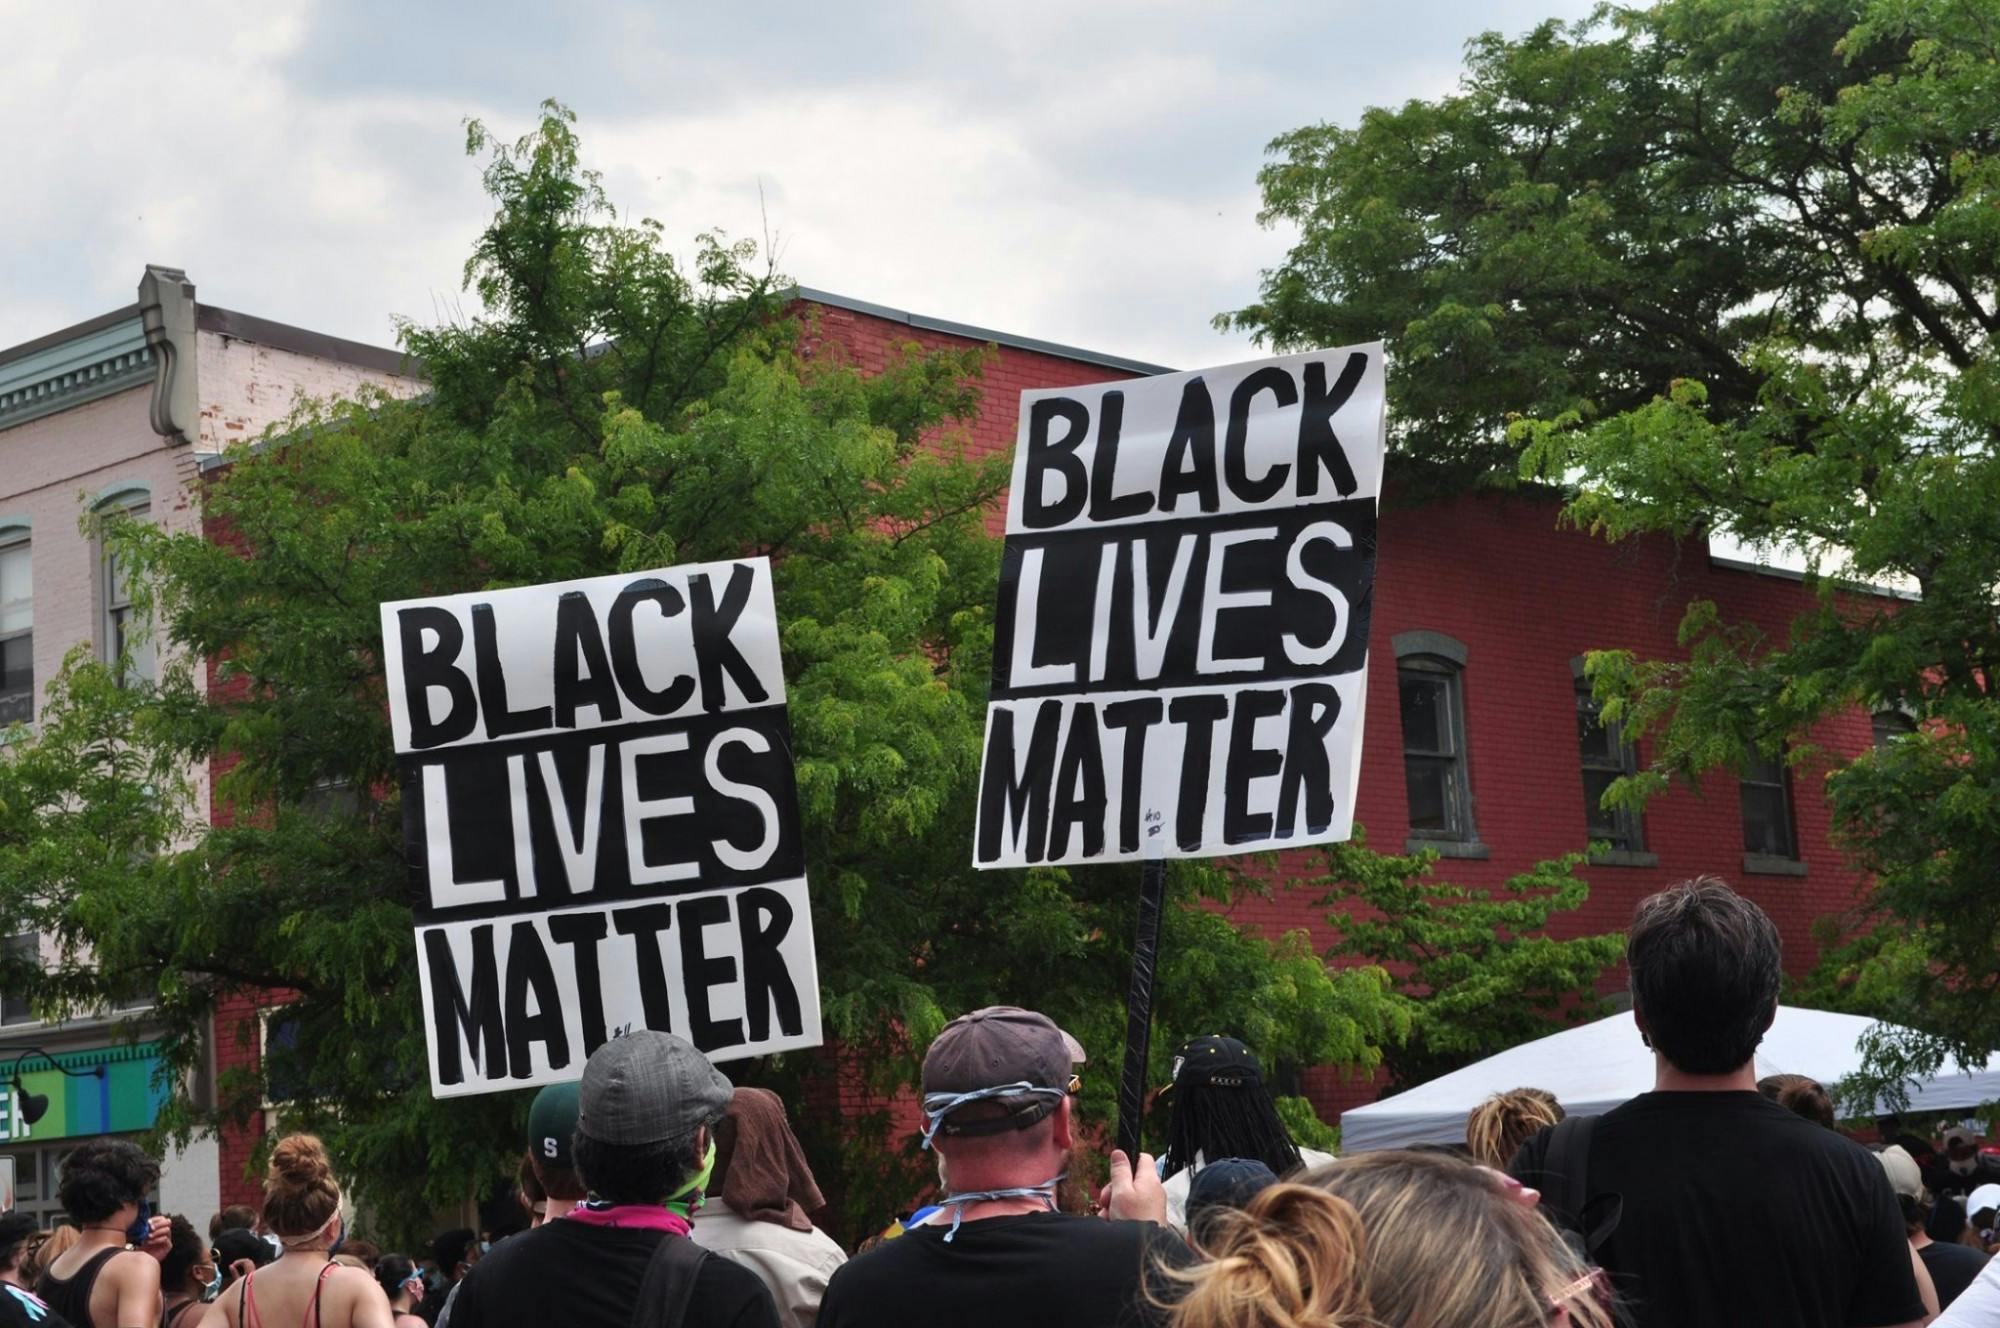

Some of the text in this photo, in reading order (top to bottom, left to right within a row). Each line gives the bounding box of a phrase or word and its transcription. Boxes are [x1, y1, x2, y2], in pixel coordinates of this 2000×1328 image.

[1022, 352, 1368, 529] BLACK
[397, 563, 769, 749] BLACK
[1008, 520, 1353, 688] LIVES
[421, 727, 781, 909] LIVES
[977, 682, 1341, 863] MATTER
[423, 887, 804, 1085] MATTER
[543, 1136, 558, 1158] S
